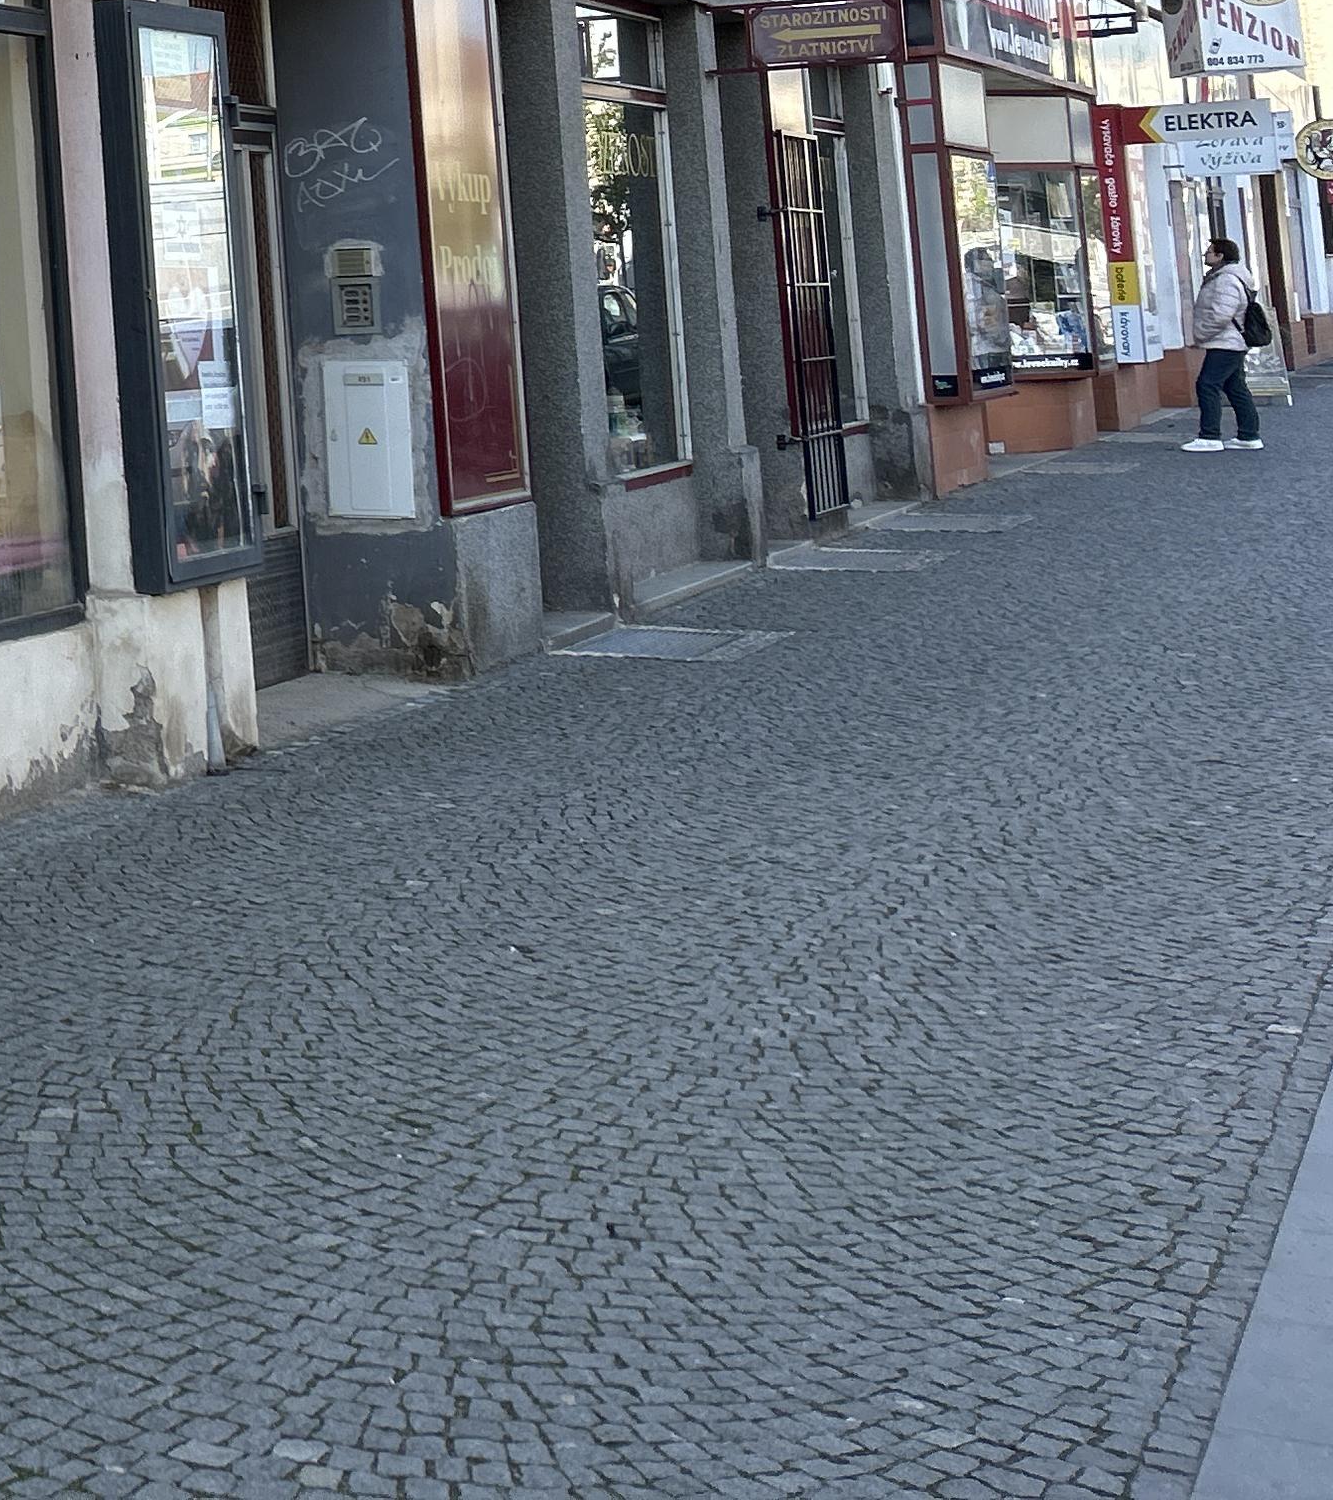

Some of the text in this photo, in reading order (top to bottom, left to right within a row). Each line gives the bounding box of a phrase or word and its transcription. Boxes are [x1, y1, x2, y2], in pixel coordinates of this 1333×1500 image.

[759, 5, 887, 29] STAROŽITNOSTI
[777, 36, 875, 58] ZLATNICTVÍ
[1164, 110, 1258, 132] ELEKTRA
[1199, 150, 1263, 170] výživa
